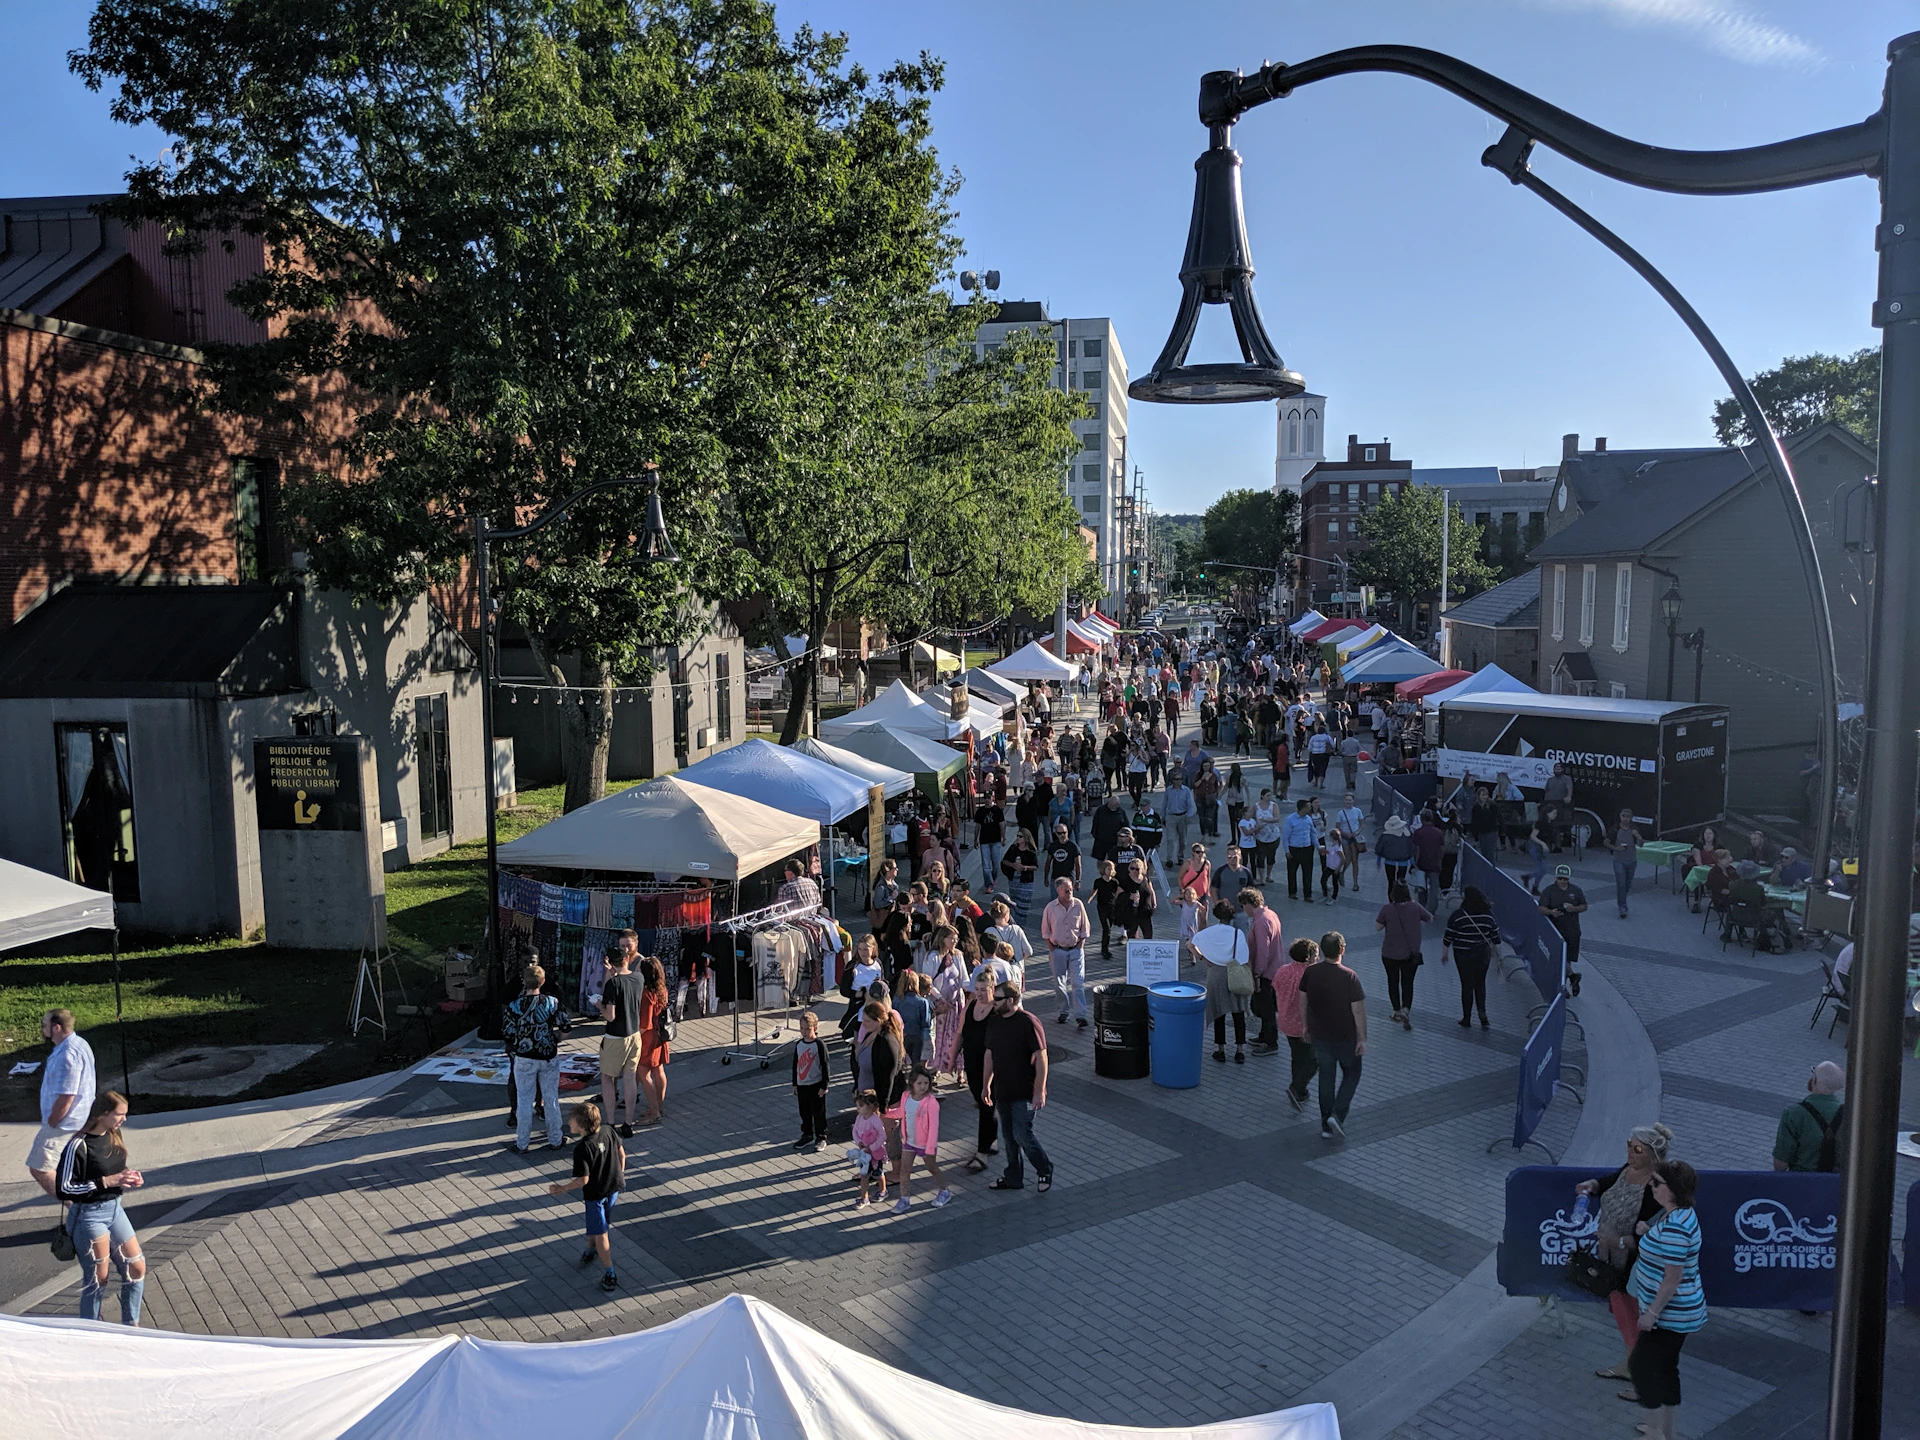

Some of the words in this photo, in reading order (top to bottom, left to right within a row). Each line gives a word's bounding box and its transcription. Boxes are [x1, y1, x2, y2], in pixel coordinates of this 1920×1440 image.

[1545, 748, 1637, 771] GRAYSTONE
[1675, 746, 1715, 762] GRAYSTONE
[270, 757, 312, 766] PUBLIQUE
[316, 757, 327, 766] de
[270, 768, 330, 777] FREDERICTON
[1565, 767, 1616, 780] BREWING
[271, 779, 302, 787] PUBLIC
[305, 779, 341, 788] LIBRARY
[1540, 1231, 1600, 1254] Garr
[1734, 1244, 1776, 1253] MARCHÉ
[1777, 1245, 1790, 1253] EN
[1792, 1244, 1827, 1254] SOIRÉE
[1828, 1246, 1837, 1254] D
[1541, 1253, 1569, 1266] NIG
[1733, 1251, 1837, 1274] garniso
